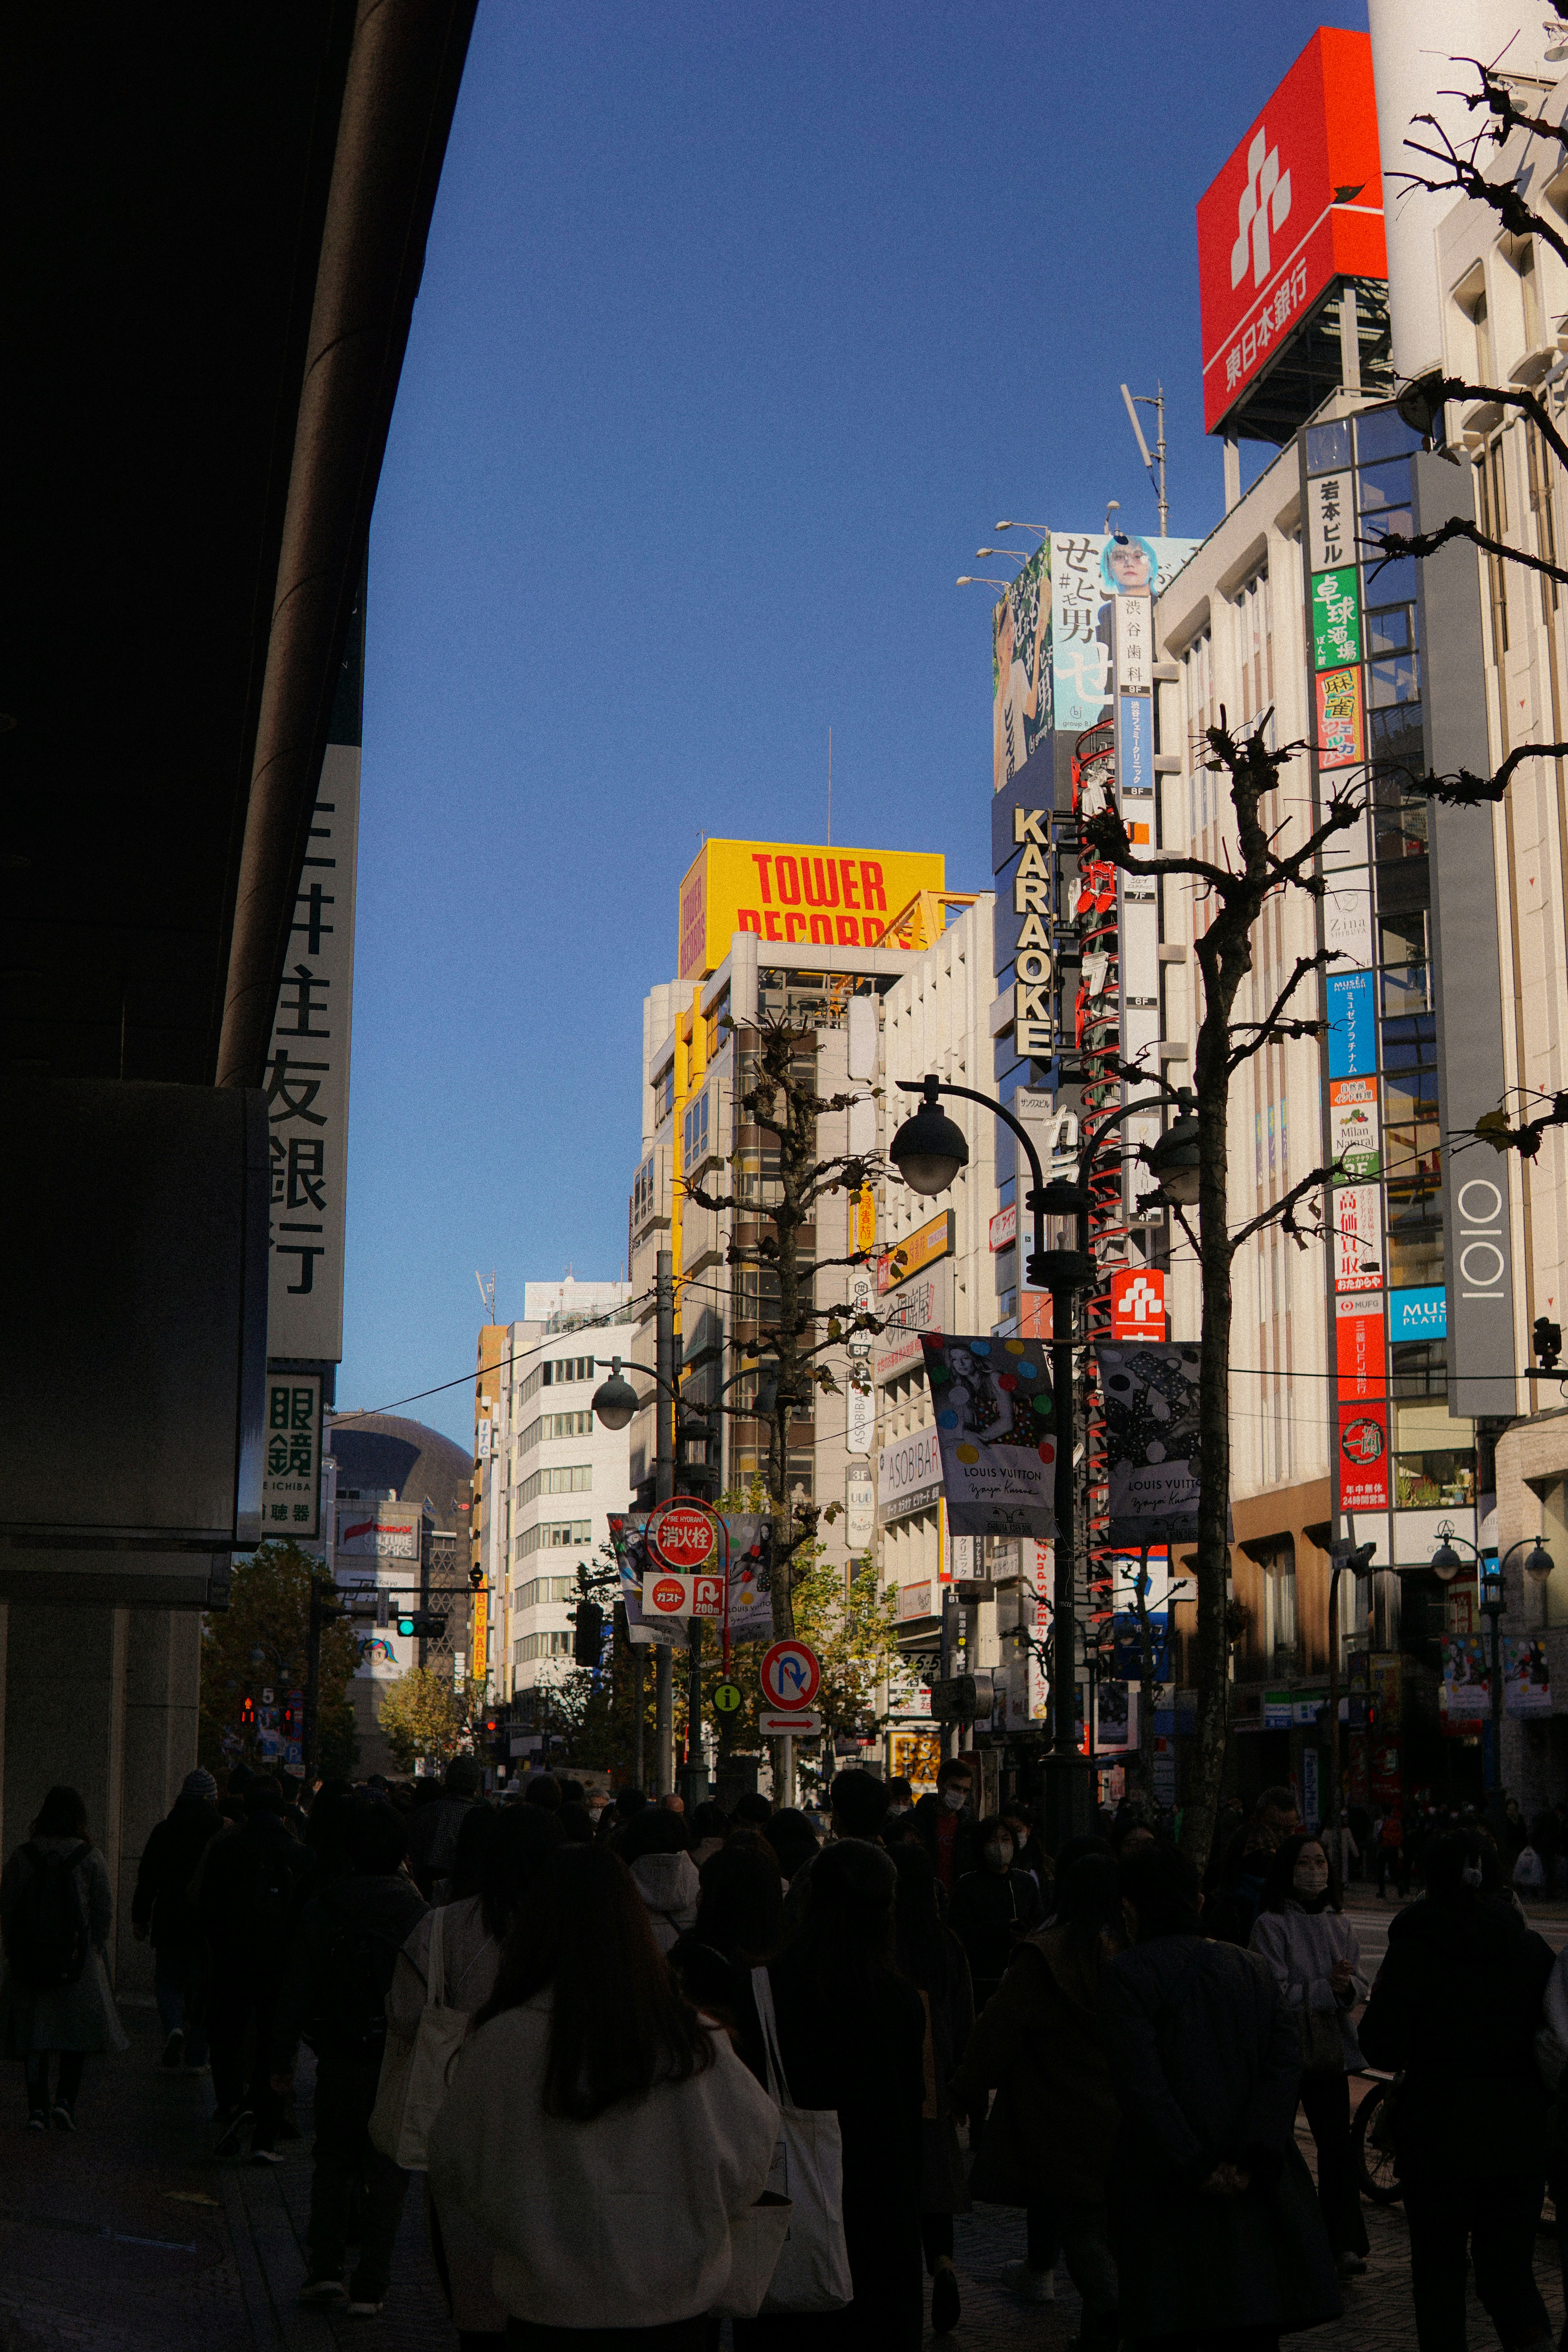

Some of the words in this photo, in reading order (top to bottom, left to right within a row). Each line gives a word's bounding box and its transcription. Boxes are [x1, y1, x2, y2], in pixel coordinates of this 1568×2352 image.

[1226, 256, 1307, 392] 東日本銀行
[1320, 480, 1343, 564] 岩本ビル
[1313, 574, 1357, 661] 卓球酒場
[1125, 599, 1143, 683] 渋谷歯科
[1323, 669, 1355, 719] 麻雀
[1131, 700, 1142, 784] 渋谷フェミークリニック
[751, 853, 887, 912] TOWER
[683, 875, 702, 936] TOWER
[737, 908, 911, 950] RECORD
[1013, 807, 1054, 1057] KARAOKE
[1330, 917, 1366, 932] Zina
[1330, 928, 1367, 938] SHIBUYA
[680, 911, 705, 979] RECORDS
[1135, 997, 1149, 1005] 6F
[1347, 992, 1357, 1073] ミュゼプラチナム
[1341, 1081, 1366, 1094] 自然派
[1020, 1098, 1050, 1108] サンクスビル
[1334, 1091, 1373, 1104] インド料理
[1341, 1126, 1369, 1138] Milan
[1336, 1135, 1374, 1150] Nataraj
[1138, 1213, 1152, 1222] 4F
[1340, 1191, 1359, 1275] 高価買取
[1337, 1277, 1381, 1291] おたからや
[1355, 1300, 1379, 1308] MUFG
[1402, 1301, 1447, 1317] MUS
[1403, 1315, 1447, 1326] PLATI
[853, 1345, 868, 1356] 5F
[1356, 1320, 1367, 1394] 三菱UFJ銀行
[480, 1421, 489, 1456] ITC
[1343, 1422, 1381, 1456] 一蘭
[888, 1435, 938, 1492] ASOBIBAR
[853, 1470, 868, 1480] 3F
[964, 1467, 997, 1477] LOUIS
[999, 1469, 1042, 1481] VUITTON
[272, 1482, 311, 1491] ICHIBA
[1129, 1480, 1162, 1491] LOUIS
[1165, 1479, 1202, 1489] VUITTO
[1346, 1483, 1383, 1495] 年中無休
[898, 1497, 912, 1512] カラオケ
[1168, 1491, 1201, 1505] Kusam
[1343, 1494, 1386, 1506] 24時間営業
[679, 1515, 705, 1524] HYDRANT
[373, 1524, 412, 1534] SHIDAX
[987, 1522, 1008, 1533] SHIBUYA
[662, 1526, 710, 1550] 消火栓
[1037, 1553, 1047, 1580] 2nd
[656, 1592, 683, 1603] ガスト
[1037, 1584, 1047, 1625] STRE
[695, 1603, 720, 1615] 200m
[475, 1580, 486, 1672] ABC-MART
[262, 1687, 274, 1704] 5
[1307, 1754, 1316, 1816] FamilyMart
